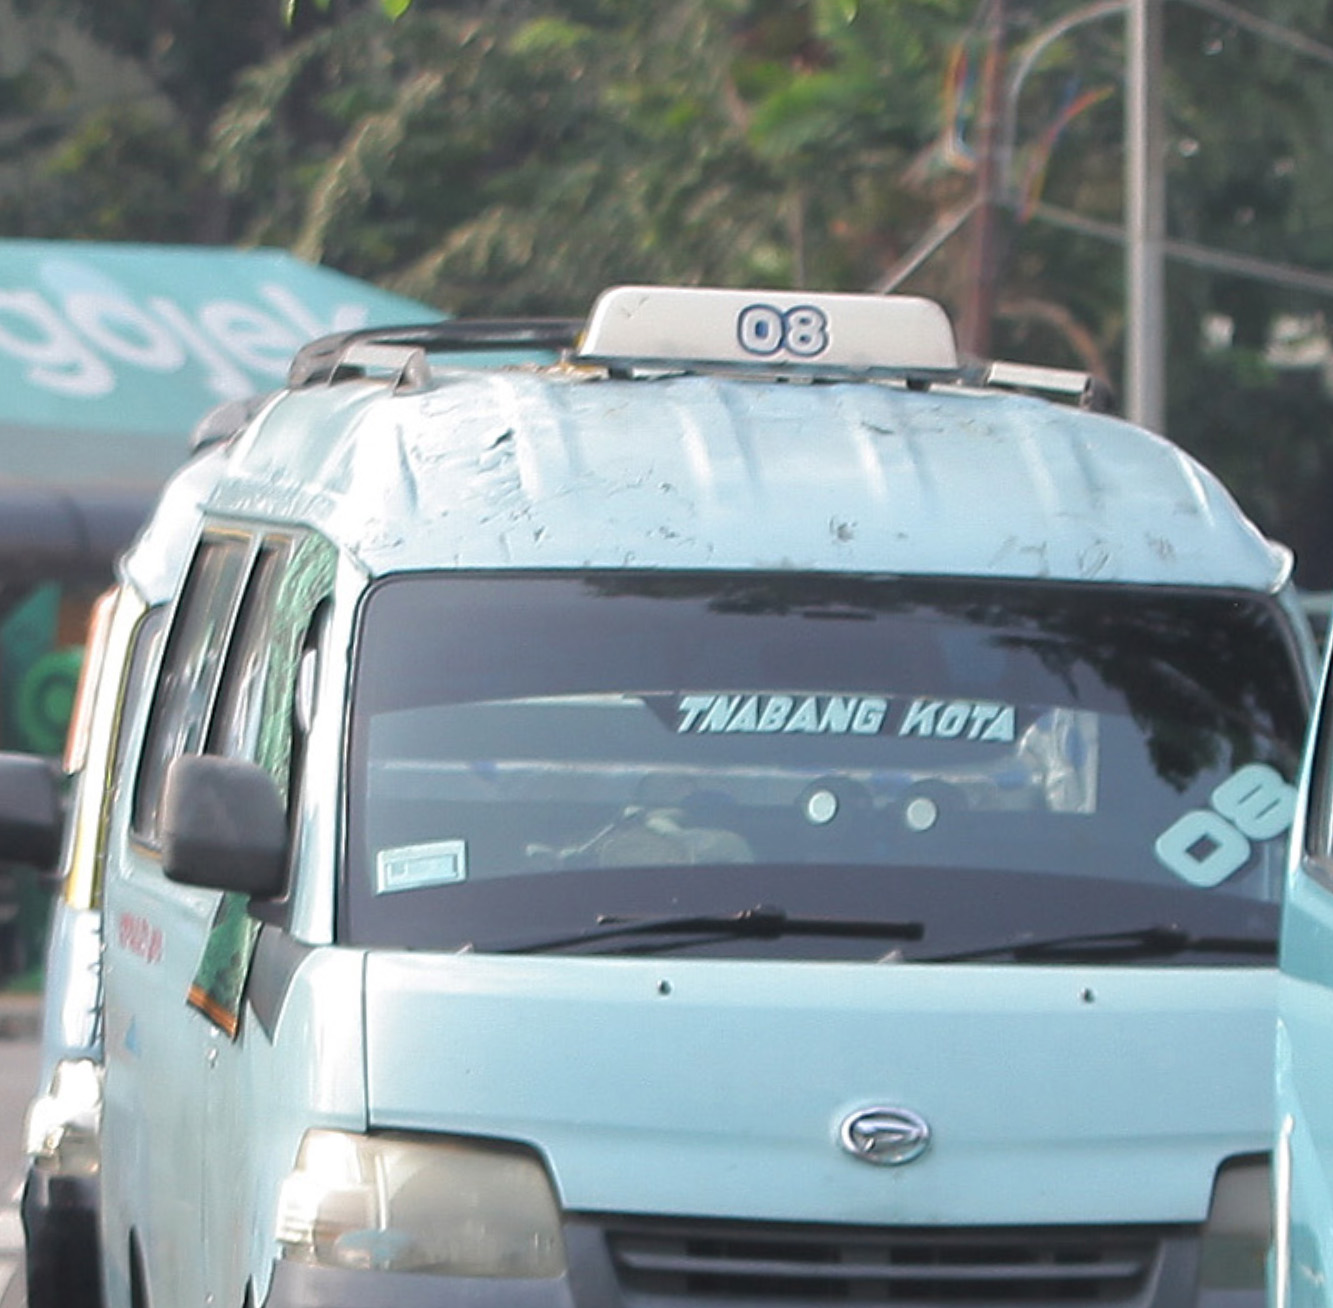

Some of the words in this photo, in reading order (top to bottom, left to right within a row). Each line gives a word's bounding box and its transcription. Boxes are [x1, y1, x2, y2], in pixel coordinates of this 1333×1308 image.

[737, 303, 830, 357] 08
[678, 694, 888, 735] TNABANG
[898, 699, 1016, 742] KOTA
[1156, 762, 1299, 888] 08
